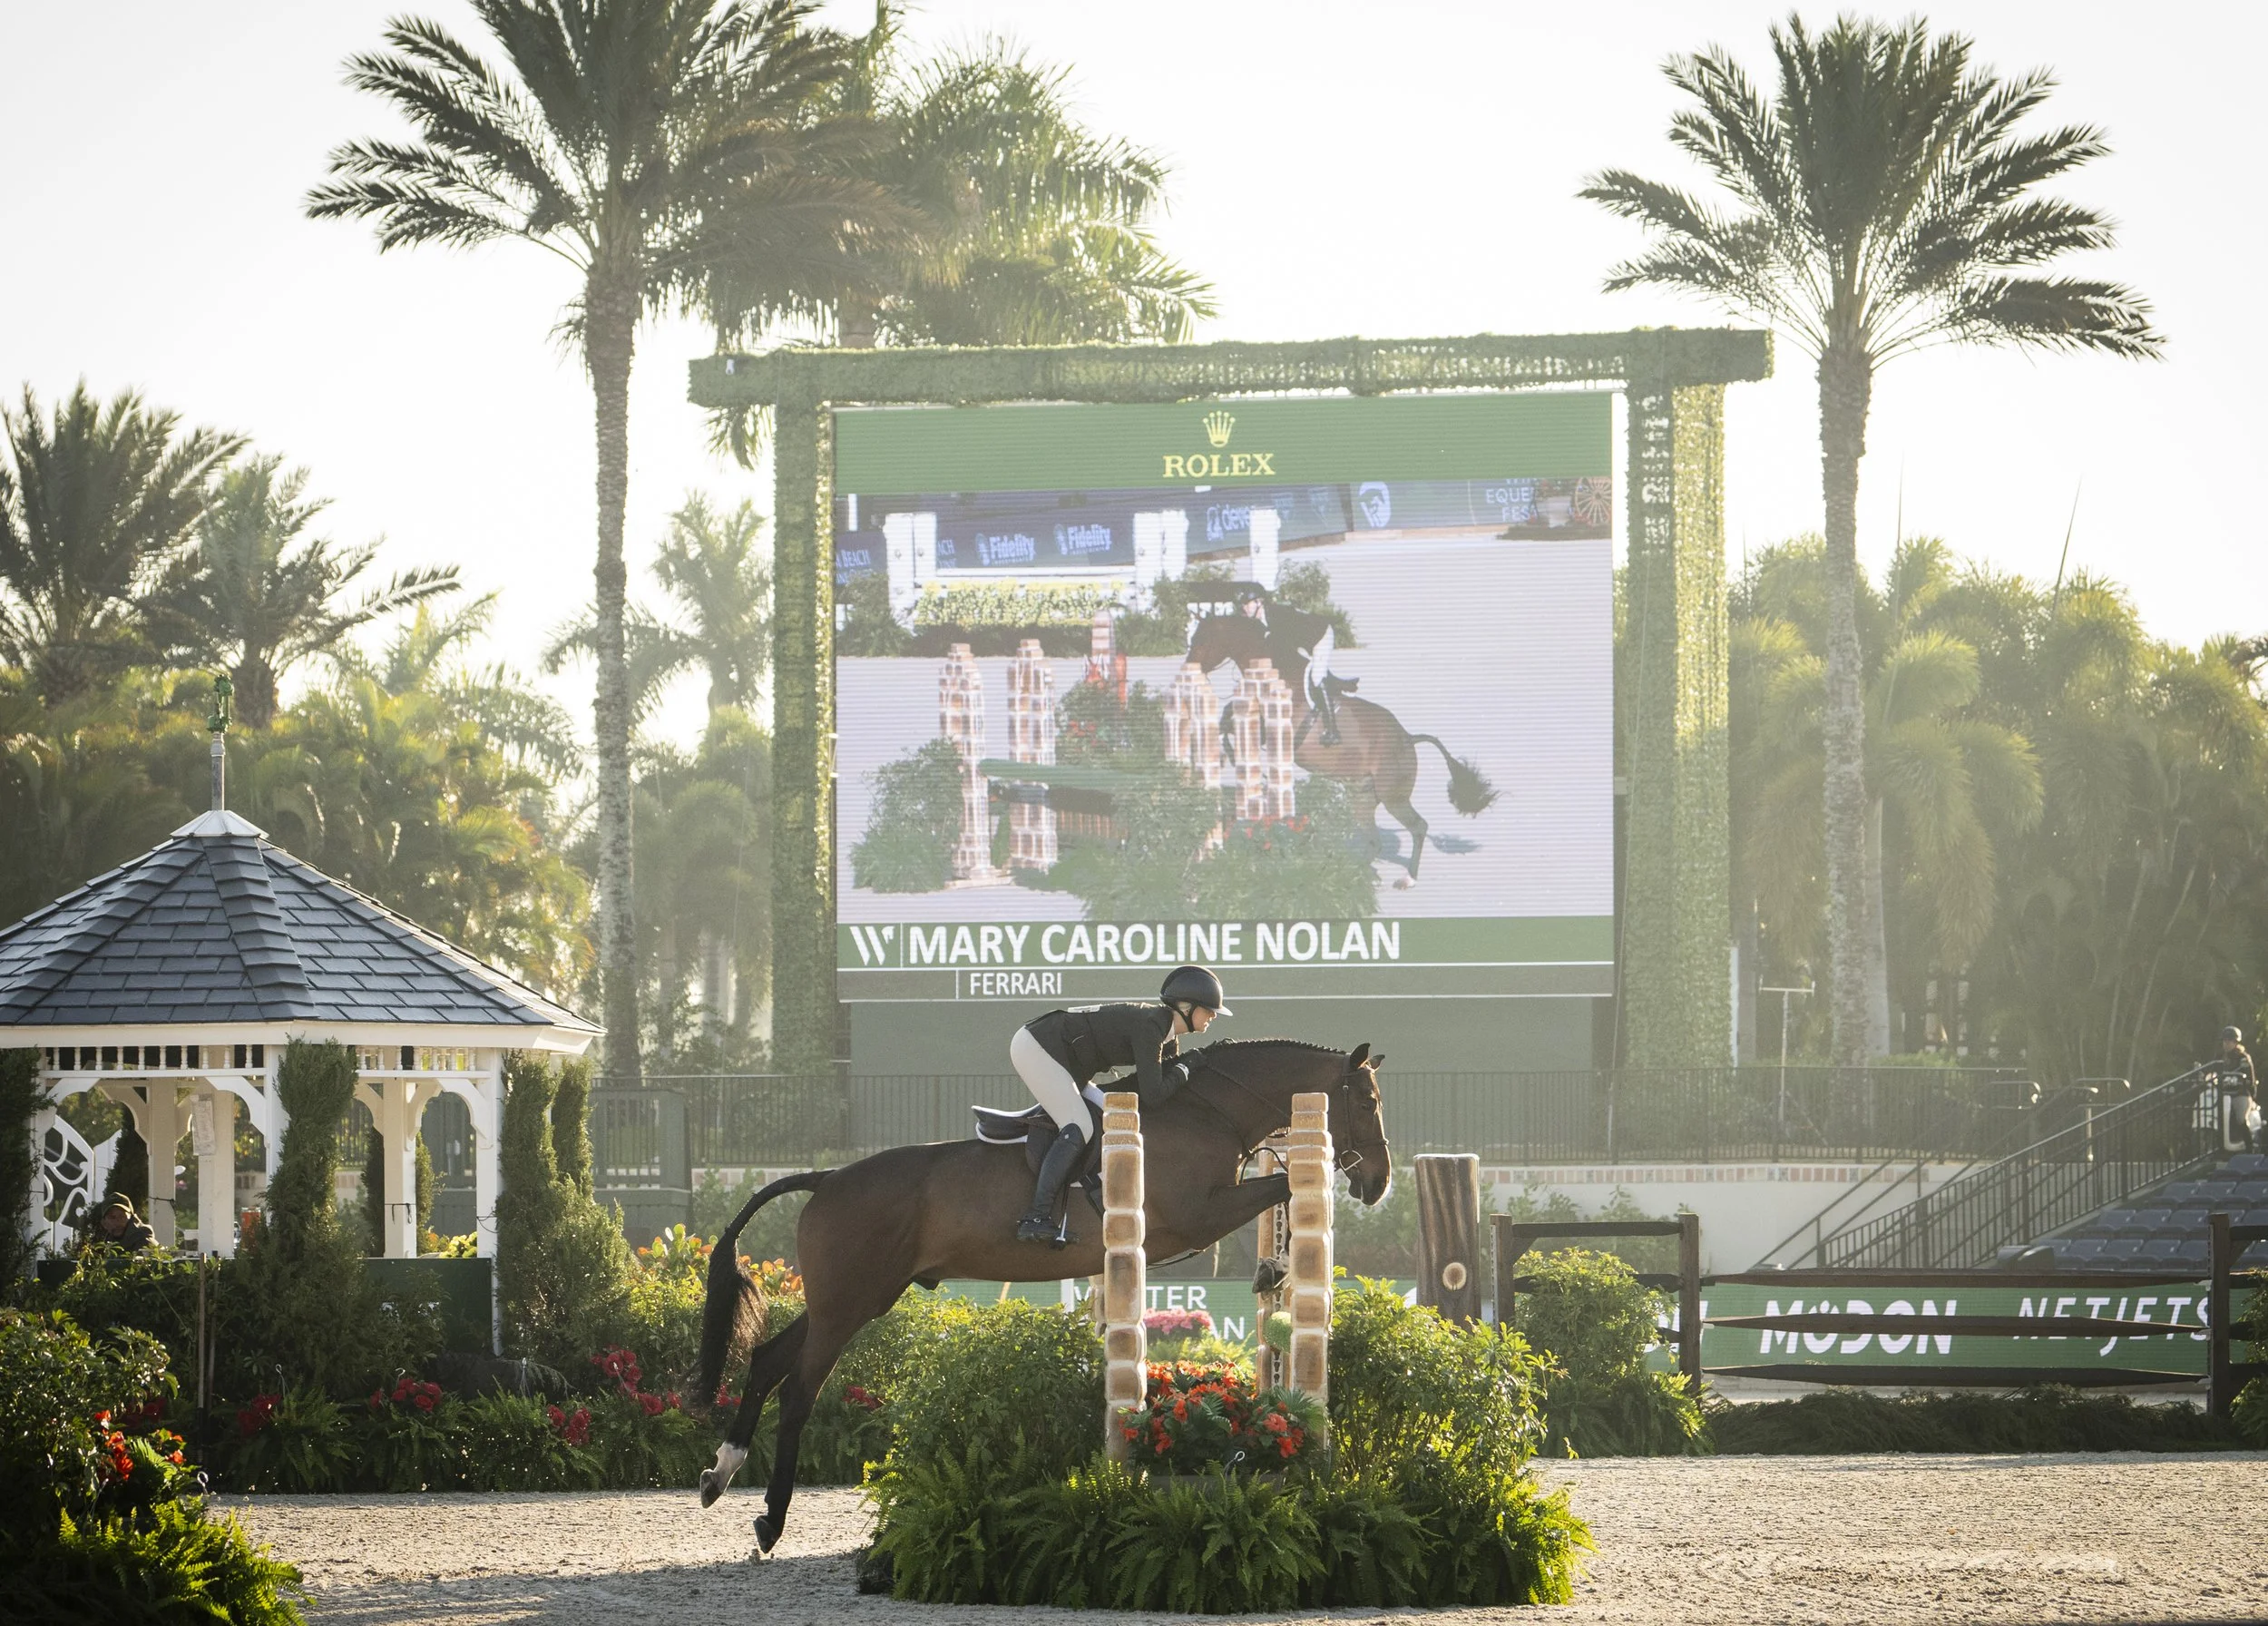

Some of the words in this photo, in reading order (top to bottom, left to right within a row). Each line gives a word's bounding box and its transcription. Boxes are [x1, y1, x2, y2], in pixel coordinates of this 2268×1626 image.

[1162, 453, 1276, 478] ROLEX
[1485, 486, 1535, 504] EQUE
[989, 533, 1037, 562] Fidelity
[1067, 524, 1112, 551] Fidelity
[840, 549, 872, 568] BEACH
[909, 925, 1031, 965] MARY
[1041, 923, 1242, 964] CAROLINE
[1256, 921, 1400, 962] NOLAN
[970, 972, 1062, 995] FERRARI
